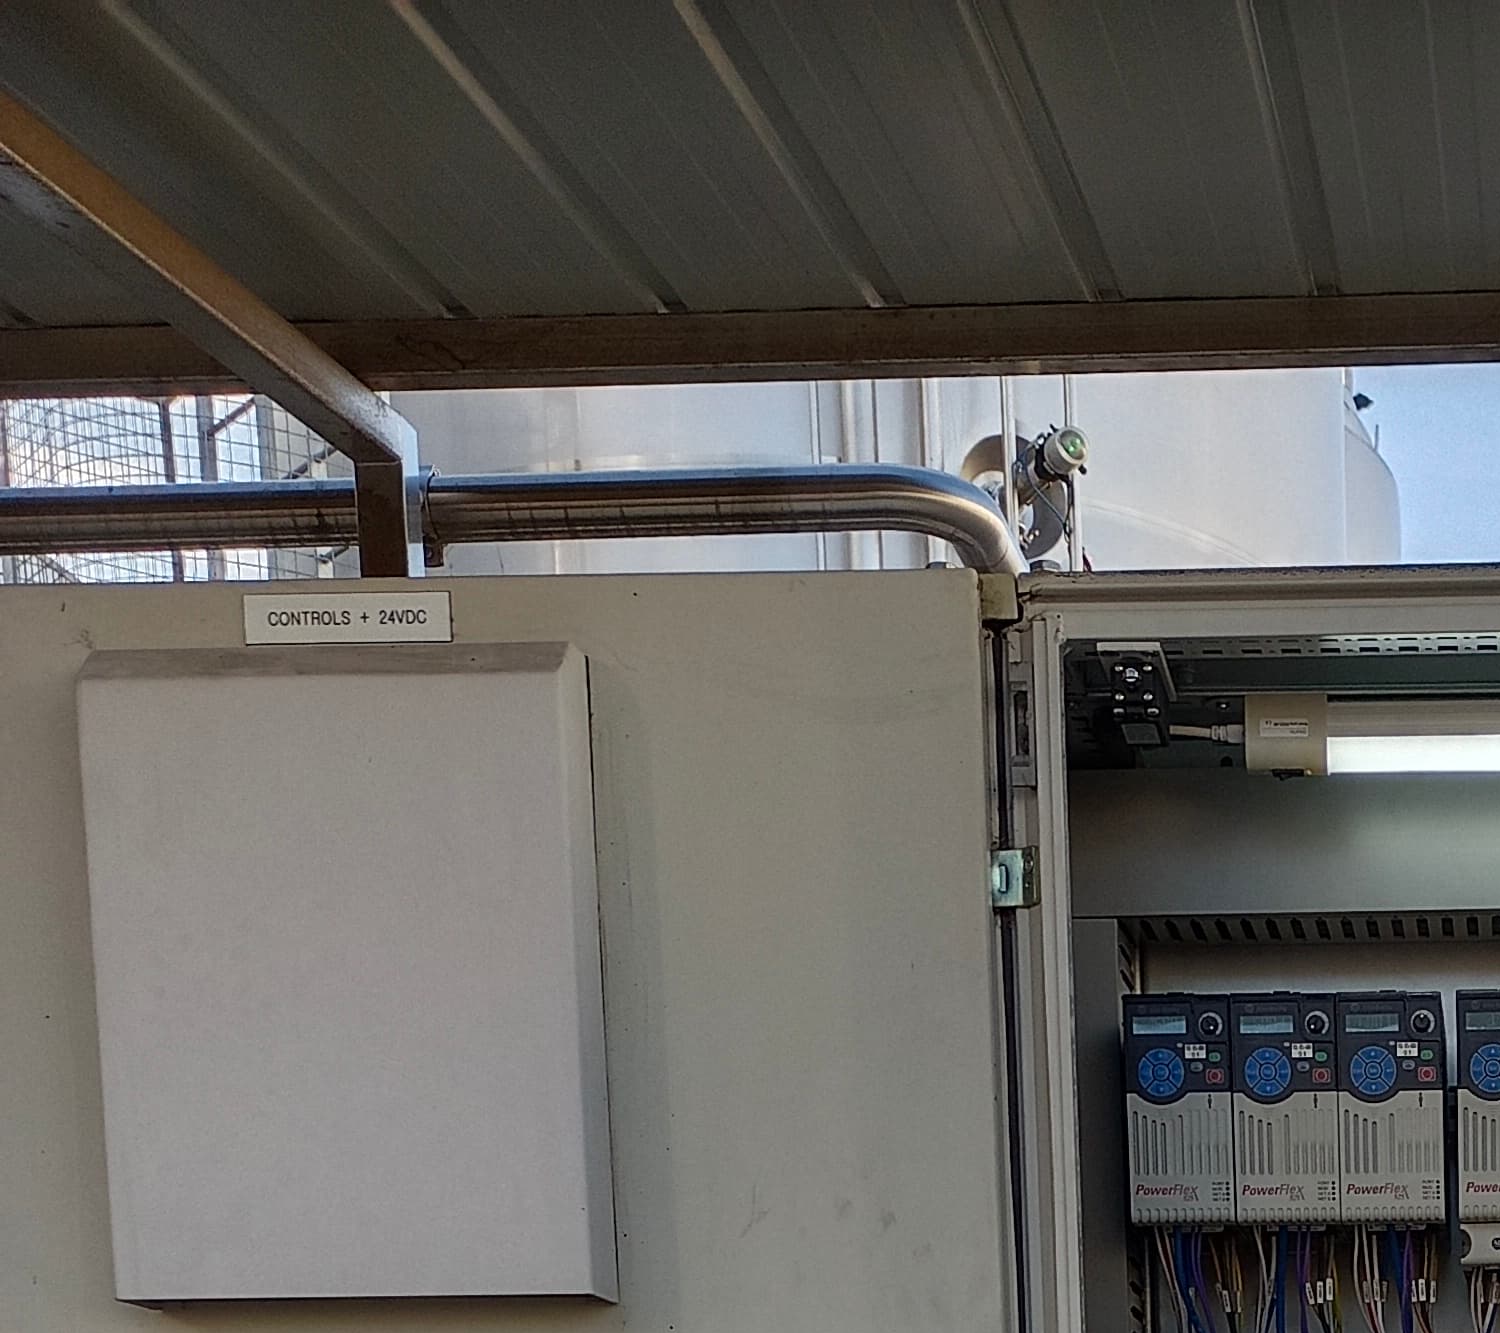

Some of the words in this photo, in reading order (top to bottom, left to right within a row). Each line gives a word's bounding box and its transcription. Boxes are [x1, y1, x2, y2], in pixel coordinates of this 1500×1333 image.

[267, 611, 351, 626] CONTROLS
[379, 609, 427, 624] 24VDC
[1136, 1184, 1199, 1202] PowerFlex
[1242, 1183, 1305, 1201] PowerFlex
[1346, 1182, 1410, 1200] PowerFlex
